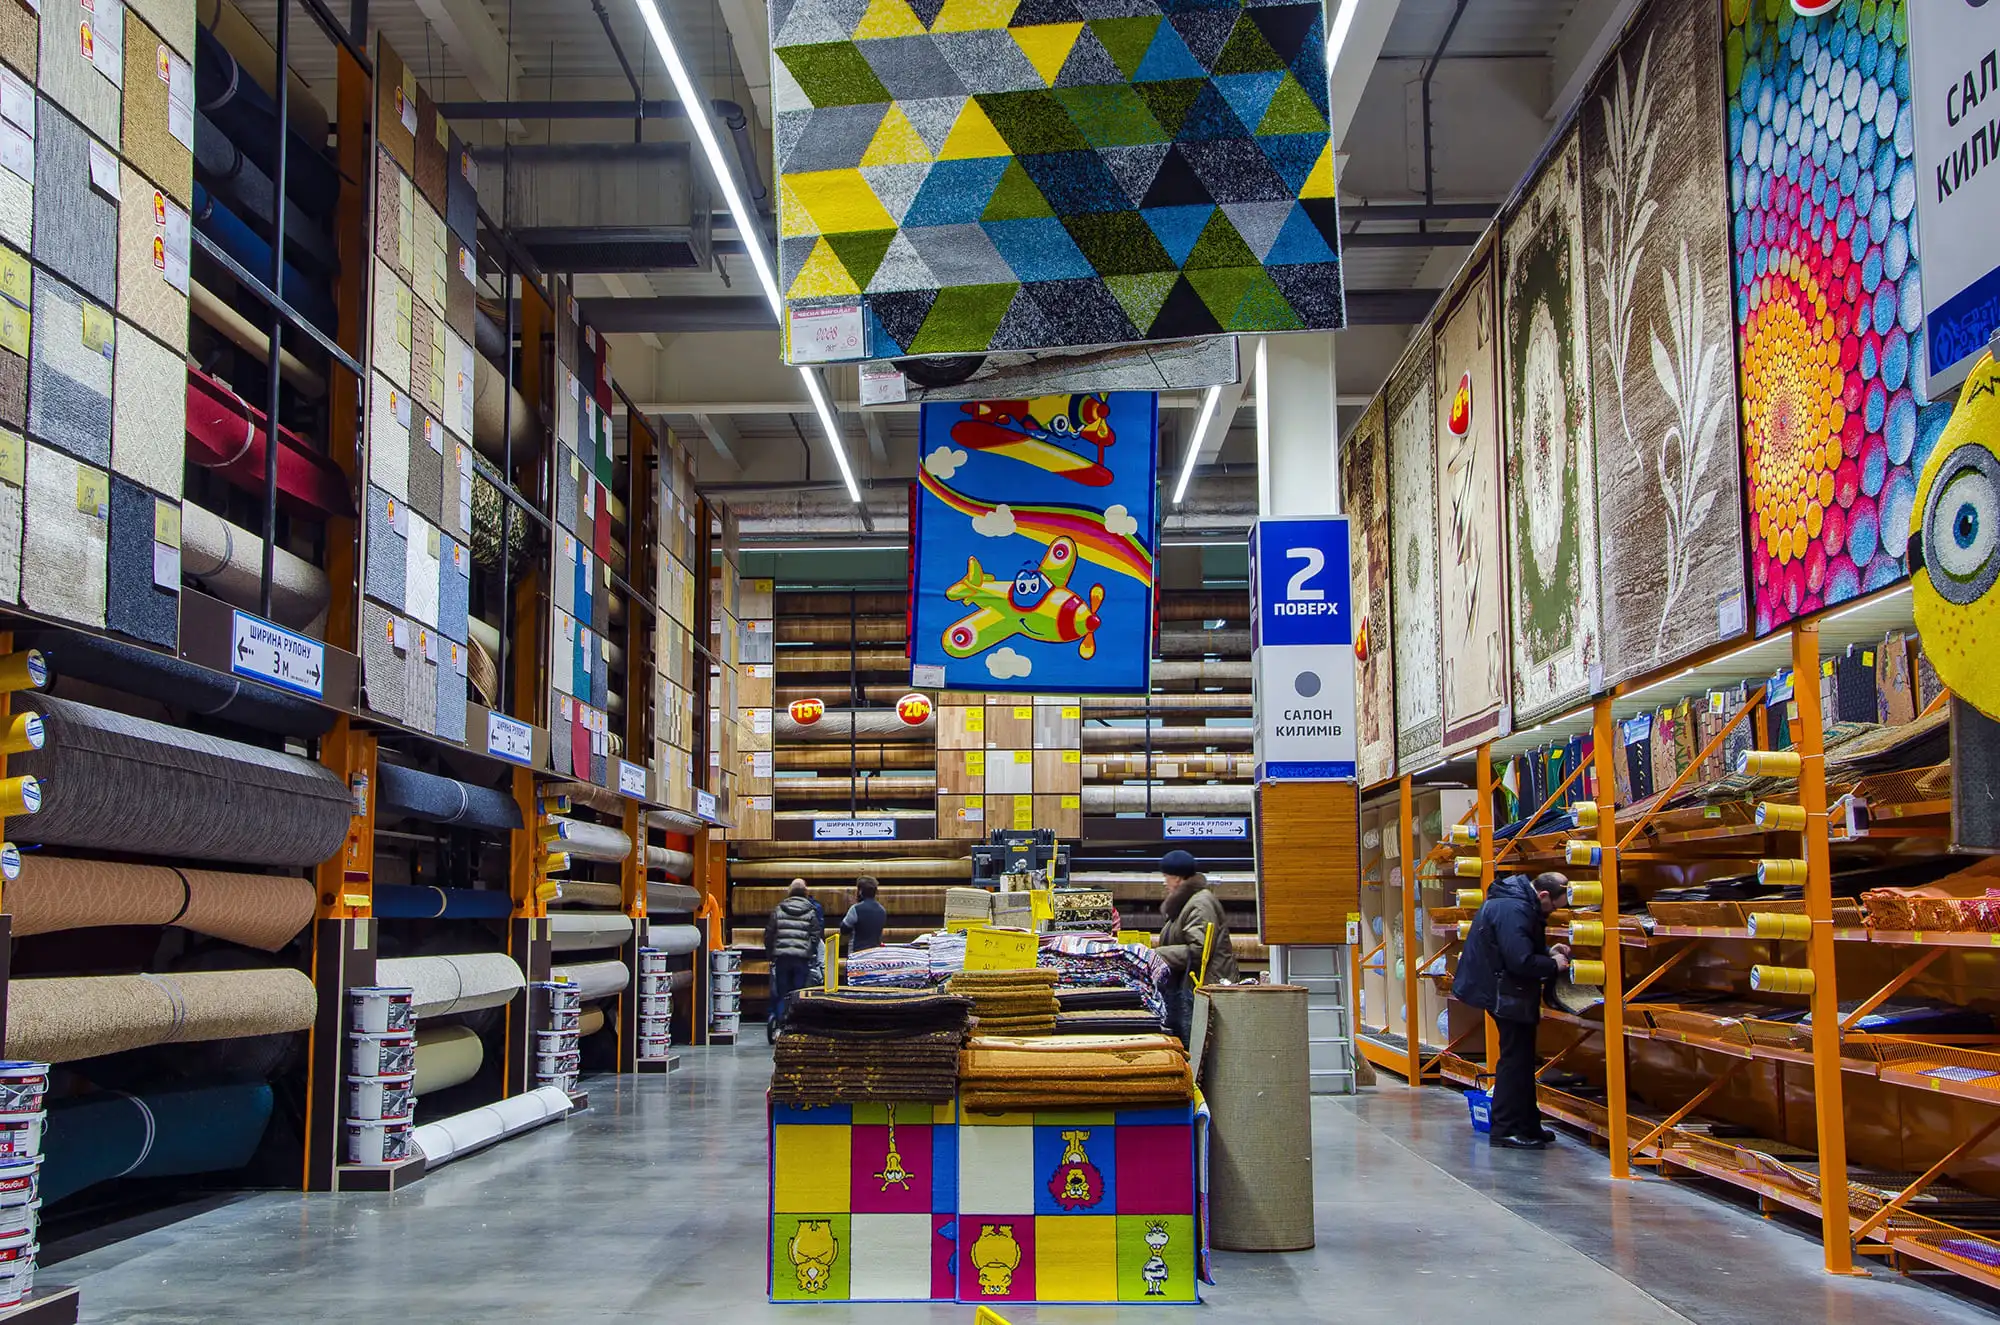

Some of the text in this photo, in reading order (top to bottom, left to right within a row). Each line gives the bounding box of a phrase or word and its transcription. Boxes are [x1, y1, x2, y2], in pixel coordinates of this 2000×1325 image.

[1286, 547, 1325, 600] 2
[1274, 602, 1339, 616] ПОВЕРХ
[250, 625, 312, 659] ШИРИНА РУЛОНУ
[273, 651, 281, 674] 3
[1284, 709, 1333, 721] САЛОН
[1276, 725, 1342, 737] КИЛИМІВ
[848, 828, 854, 836] 3
[1189, 827, 1204, 836] 3,5
